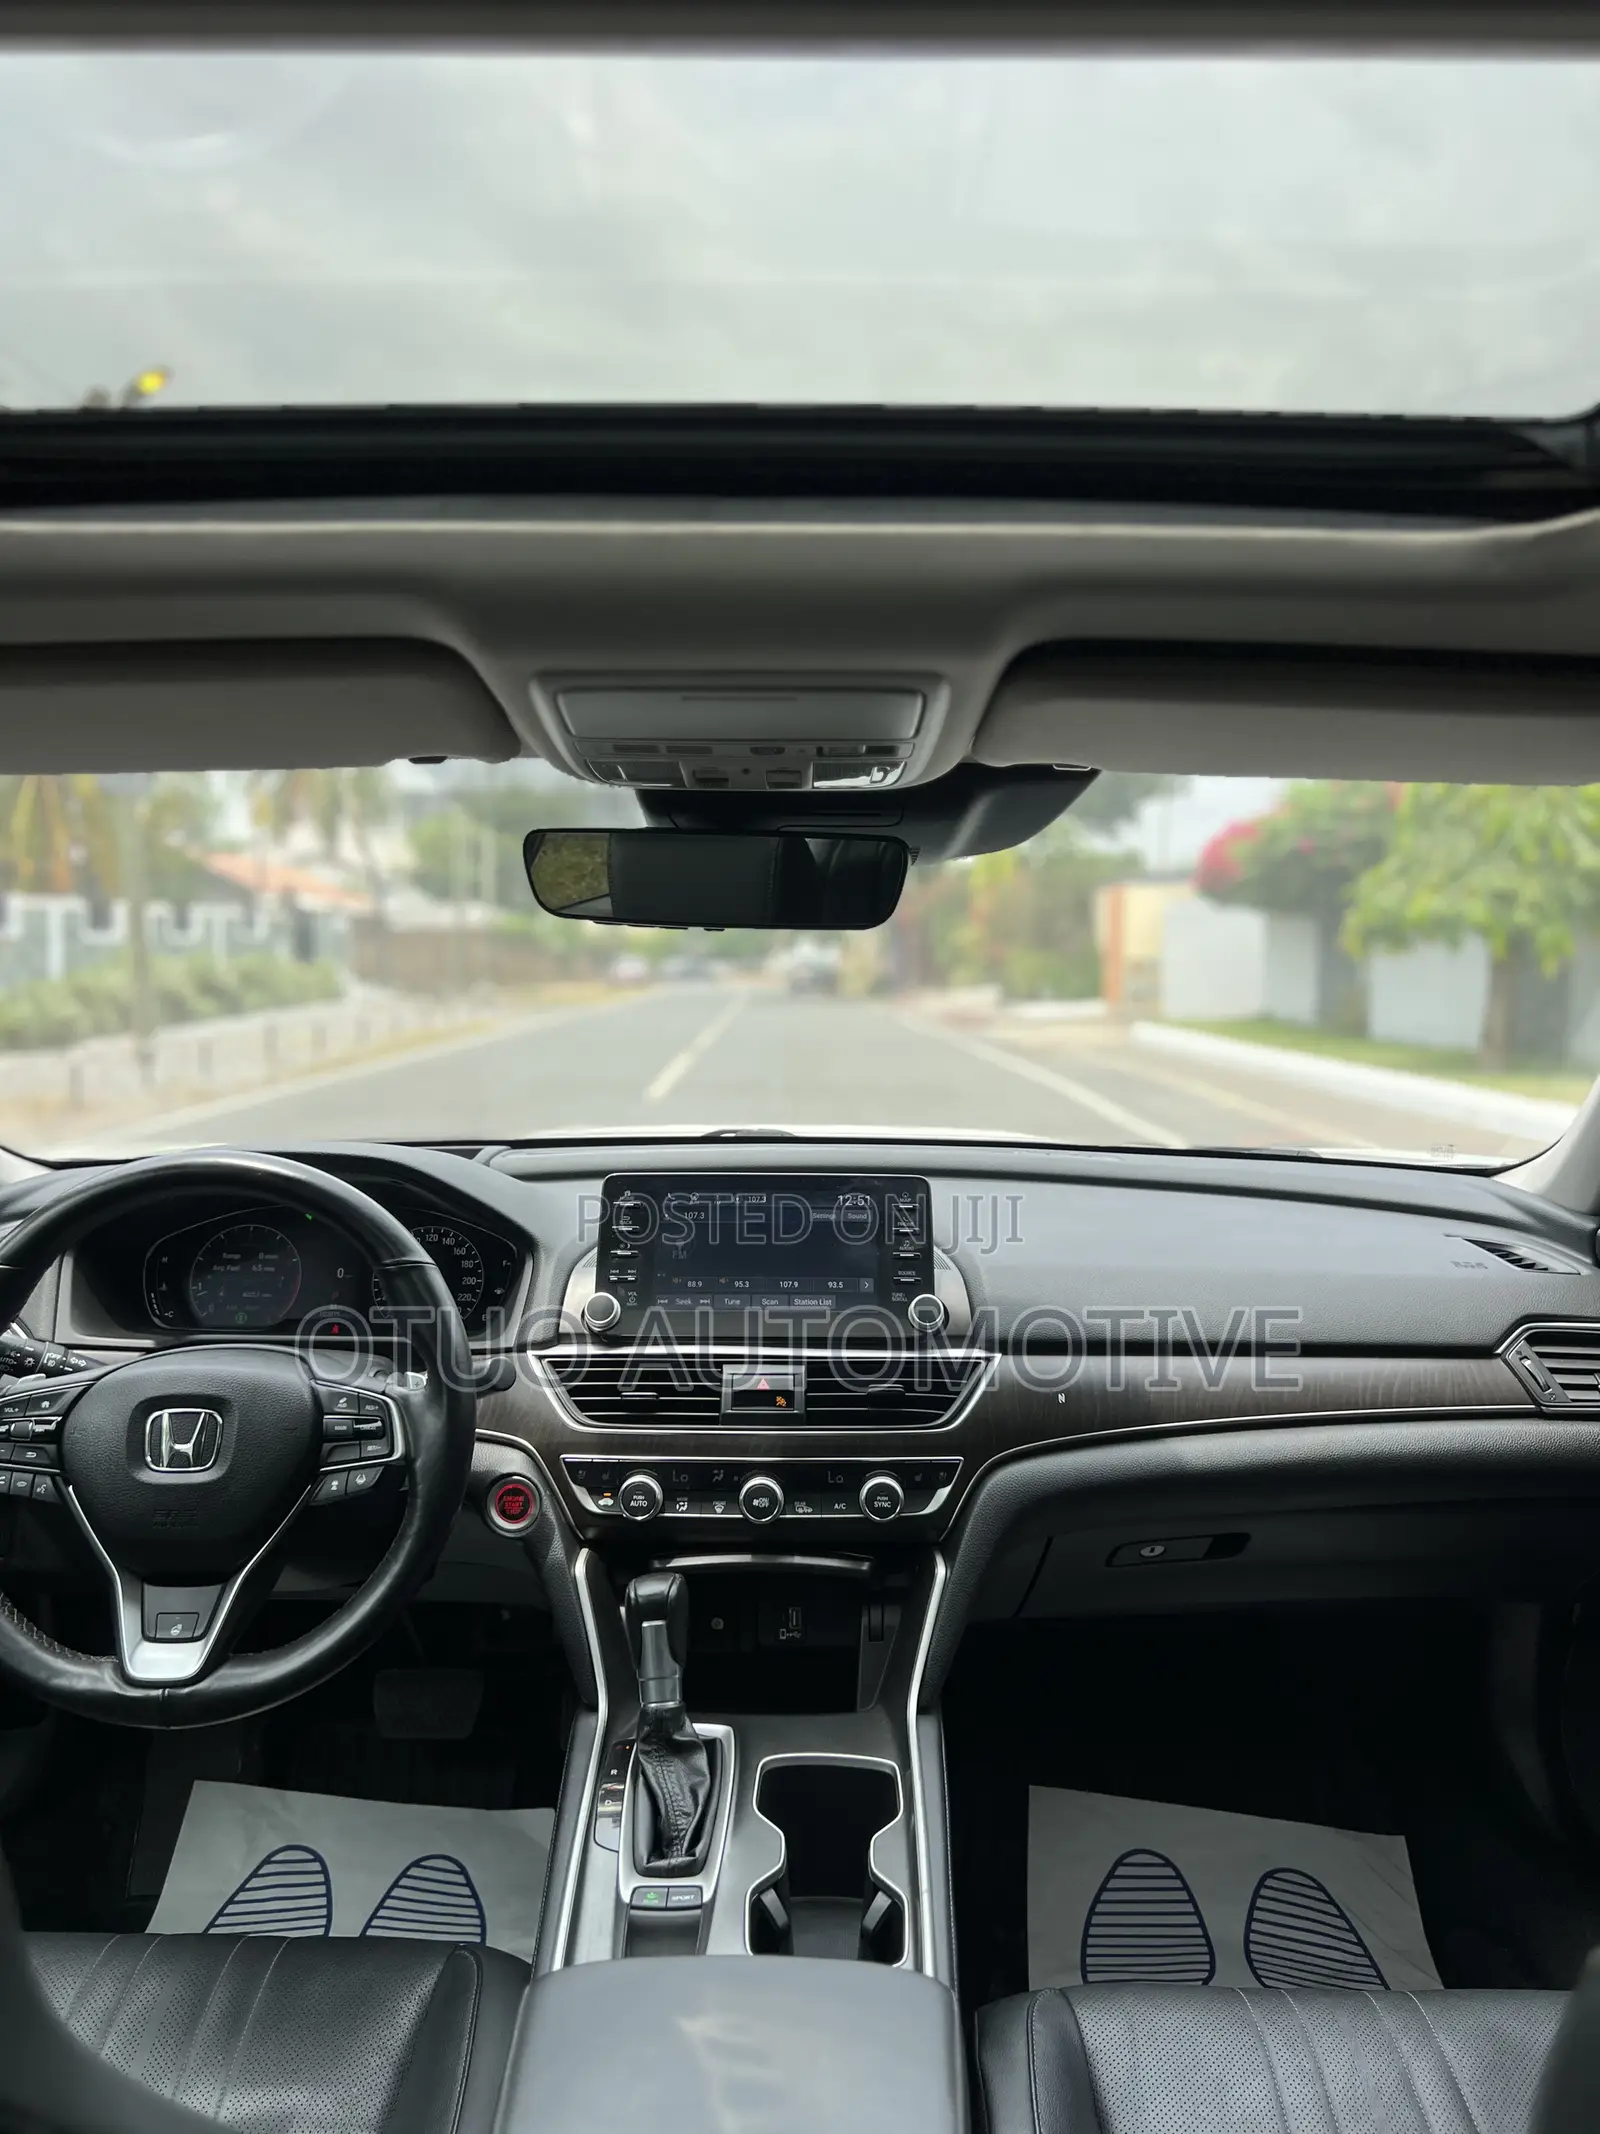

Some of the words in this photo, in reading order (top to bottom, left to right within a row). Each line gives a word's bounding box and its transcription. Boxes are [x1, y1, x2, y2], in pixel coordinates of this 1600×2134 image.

[837, 1195, 871, 1207] 12:51
[684, 1212, 705, 1220] 107.3
[812, 1212, 836, 1221] Settings
[847, 1212, 867, 1220] Sound
[425, 1233, 439, 1242] 120
[442, 1236, 456, 1246] 140
[453, 1246, 467, 1256] 160
[461, 1259, 474, 1268] 180
[462, 1276, 477, 1285] 200
[687, 1280, 703, 1288] 88.9
[734, 1280, 750, 1288] 95.3
[779, 1280, 799, 1289] 107.9
[828, 1280, 844, 1289] 93.5
[457, 1292, 472, 1301] 220
[724, 1298, 741, 1306] Tune
[794, 1298, 818, 1306] Station
[819, 1298, 832, 1306] List
[630, 1500, 648, 1508] AUTO
[834, 1502, 847, 1510] A/C
[874, 1500, 891, 1508] SYNC
